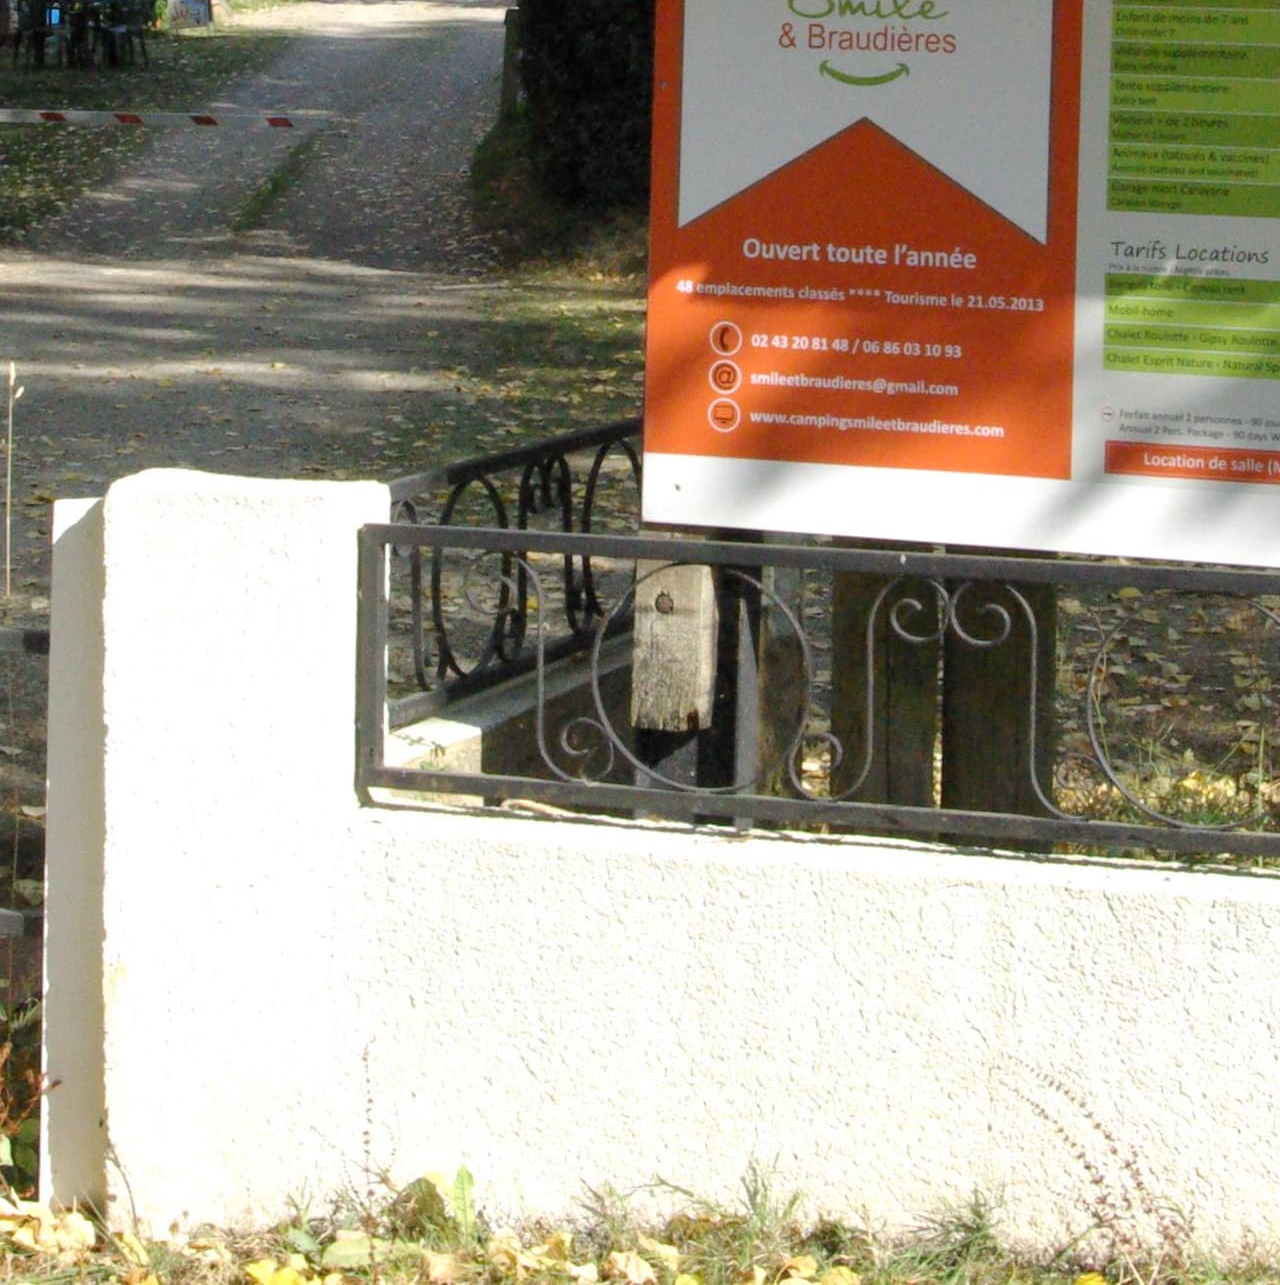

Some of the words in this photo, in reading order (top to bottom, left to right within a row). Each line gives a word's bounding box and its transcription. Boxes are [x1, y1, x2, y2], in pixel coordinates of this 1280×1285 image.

[778, 22, 797, 49] &
[808, 22, 957, 54] Braudières
[742, 237, 820, 261] Ouvert
[826, 242, 888, 265] toute
[894, 243, 977, 269] l'année
[1111, 240, 1167, 260] Tarifs
[1175, 243, 1270, 265] Locations
[675, 279, 694, 294] 48
[695, 281, 795, 298] emplacements
[798, 285, 846, 302] classés
[884, 290, 947, 307] Tourisme
[950, 293, 964, 308] le
[967, 294, 1045, 312] 21.05.2013
[751, 333, 769, 347] 02
[771, 334, 789, 349] 43
[791, 335, 809, 350] 20
[811, 337, 829, 351] 81
[832, 338, 849, 352] 48
[852, 337, 860, 355] /
[863, 340, 880, 354] 06
[883, 341, 901, 355] 86
[903, 342, 921, 356] 03
[924, 343, 941, 357] 10
[944, 345, 962, 359] 93
[1107, 327, 1141, 340] Chalet
[1144, 329, 1189, 343] Roulotte
[1199, 332, 1228, 348] Gipsy
[1231, 334, 1277, 347] Roulotte
[1106, 352, 1141, 364] Chalet
[1143, 353, 1174, 367] Esprit
[1176, 355, 1214, 369] Nature
[1223, 358, 1265, 372] Natural
[750, 372, 959, 395] smileetbraudieres@gmail.com
[749, 411, 1005, 438] www.campingsmileetbraudieres.com
[1119, 409, 1150, 420] Forfait
[1186, 412, 1192, 422] 2
[1153, 425, 1160, 435] 2
[1187, 427, 1224, 440] Package
[1247, 430, 1268, 442] days
[1143, 452, 1203, 470] Location
[1208, 455, 1227, 471] de
[1230, 457, 1264, 473] salle
